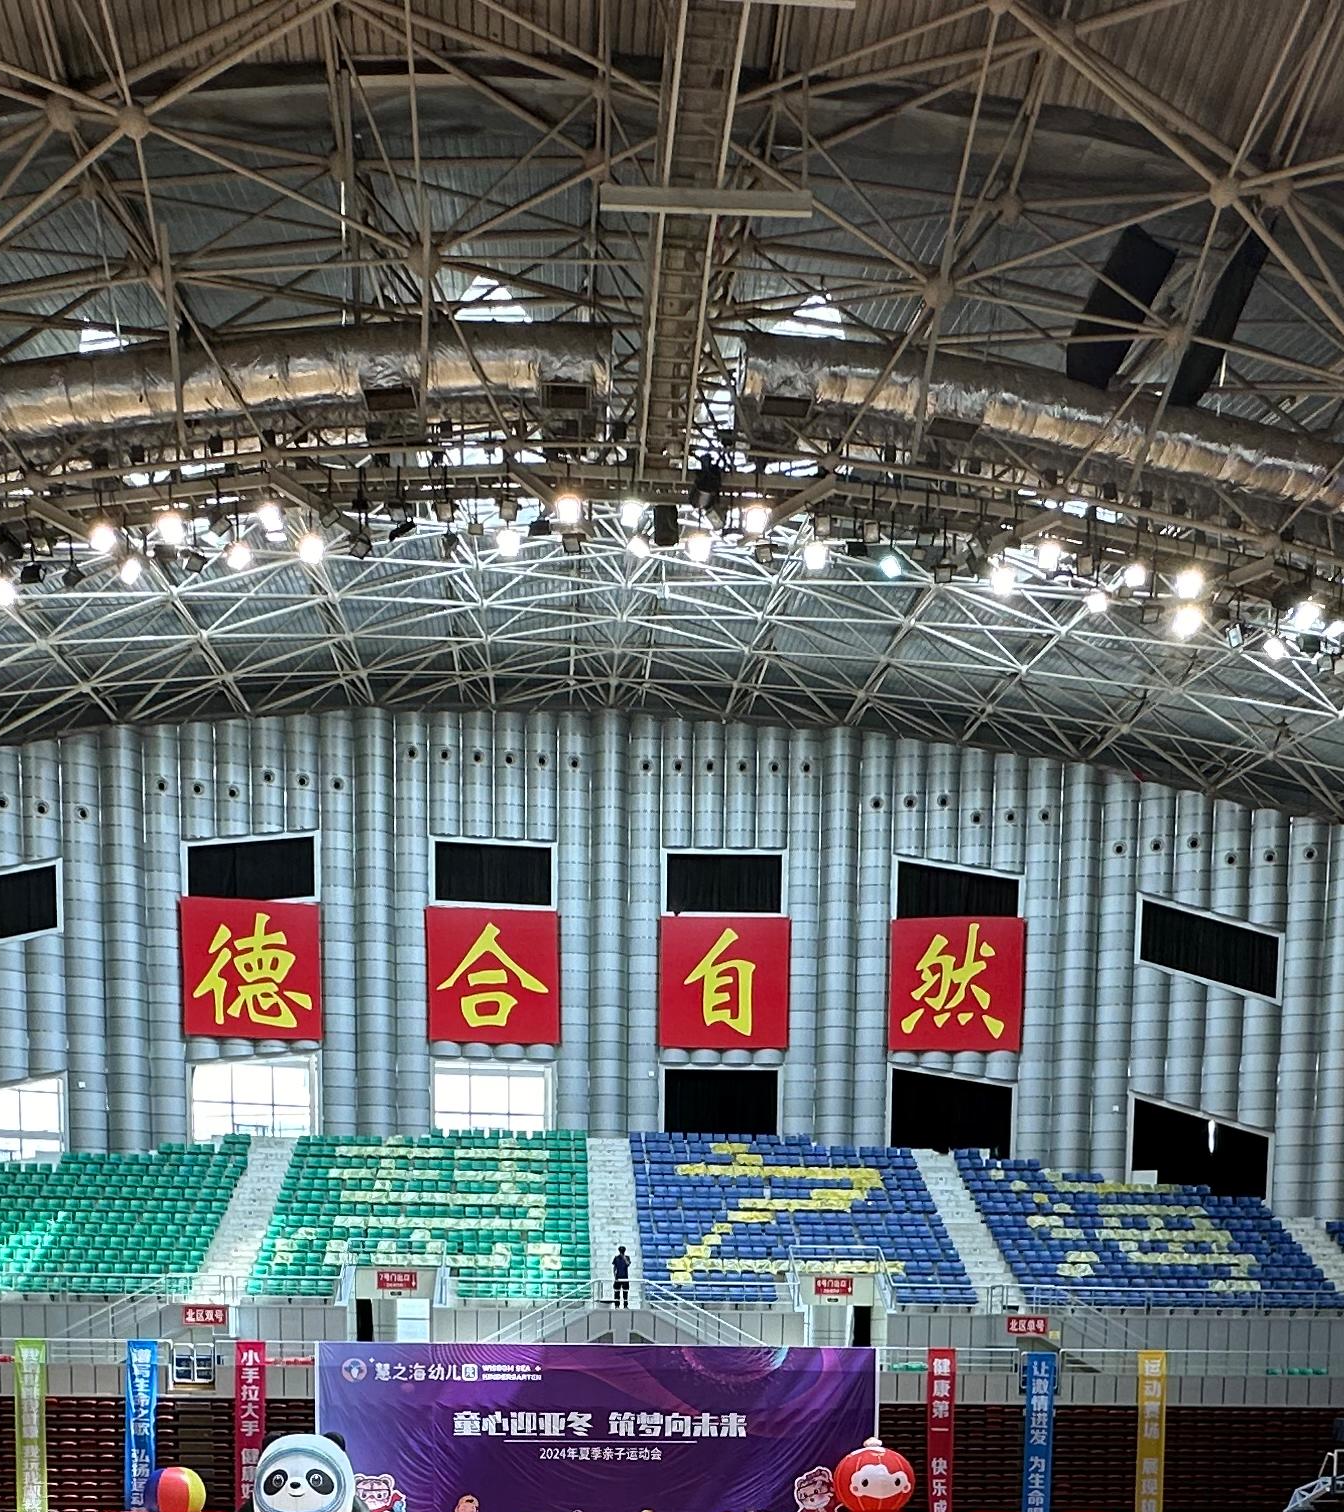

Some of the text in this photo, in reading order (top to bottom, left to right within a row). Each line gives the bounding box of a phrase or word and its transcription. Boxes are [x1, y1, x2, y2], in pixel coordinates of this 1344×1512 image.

[193, 913, 1004, 1039] 德 合 自 然
[185, 1307, 224, 1323] 北区双号
[1008, 1318, 1045, 1333] 北区单号
[374, 1363, 478, 1381] 慧之海幼儿园
[240, 1350, 260, 1437] 小手拉大手
[931, 1358, 951, 1431] 健康第一
[453, 1411, 748, 1437] 童心迎亚冬 筑梦向未来
[539, 1447, 662, 1461] 2024年夏季亲子运动会
[131, 1449, 150, 1512] 弘扬运动
